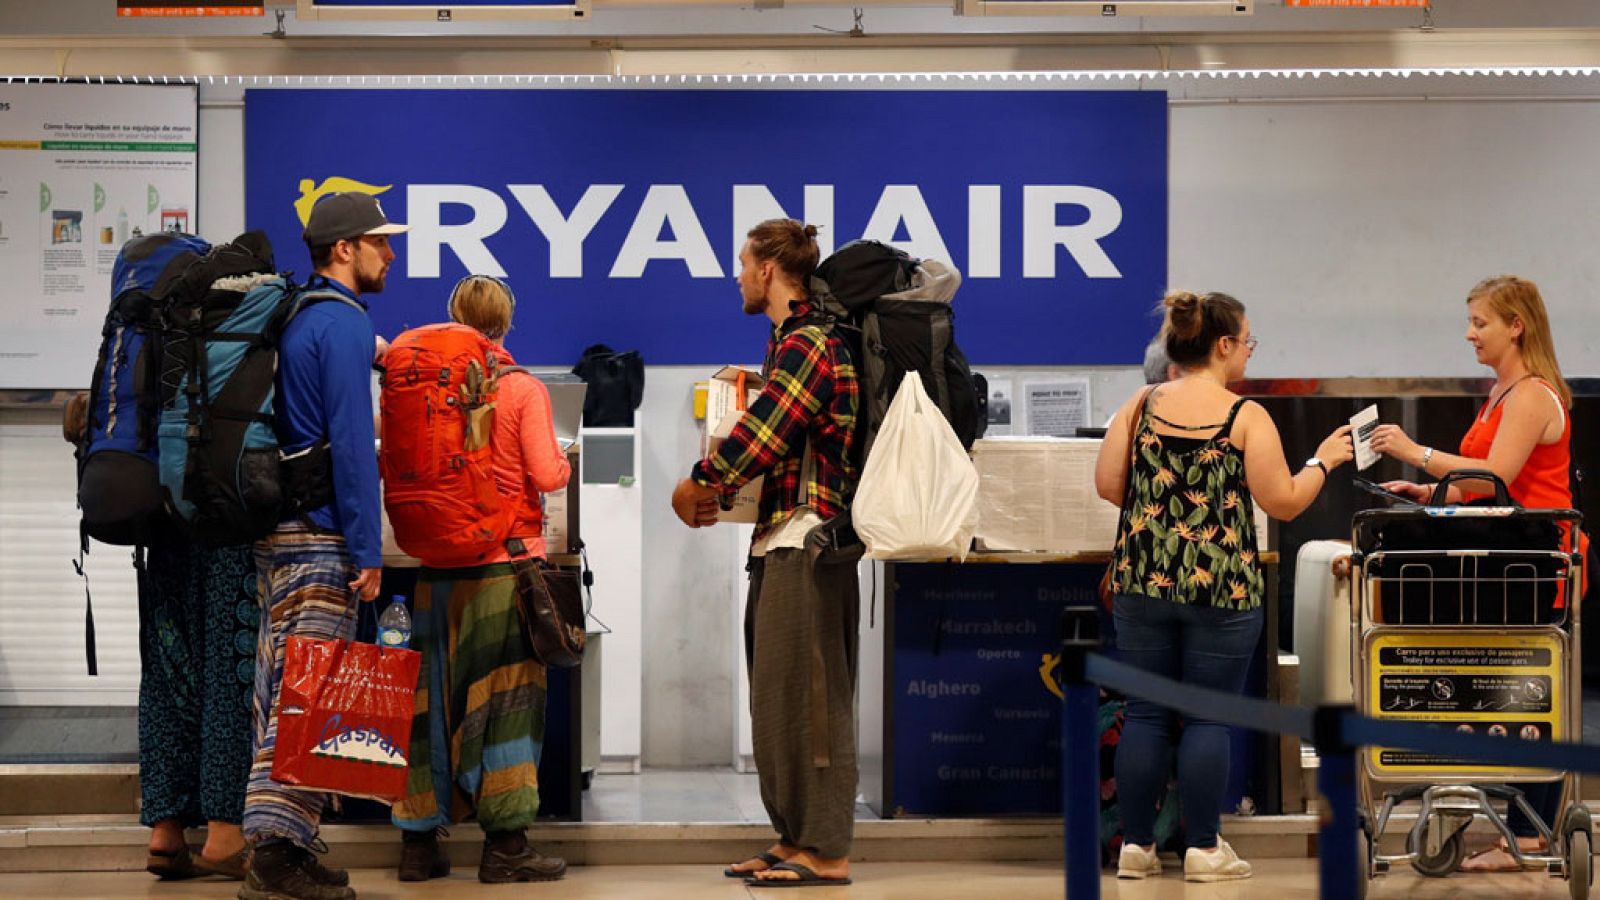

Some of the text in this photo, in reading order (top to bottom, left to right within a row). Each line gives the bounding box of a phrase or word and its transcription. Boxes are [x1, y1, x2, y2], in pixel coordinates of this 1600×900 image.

[406, 184, 1123, 279] RYANAIR
[1037, 587, 1096, 601] Dublin
[977, 648, 1021, 660] Oporto
[1396, 648, 1418, 656] Carro
[1418, 649, 1436, 657] para
[907, 680, 981, 698] Alghero
[319, 713, 405, 758] Gaspar
[937, 764, 981, 780] Gran
